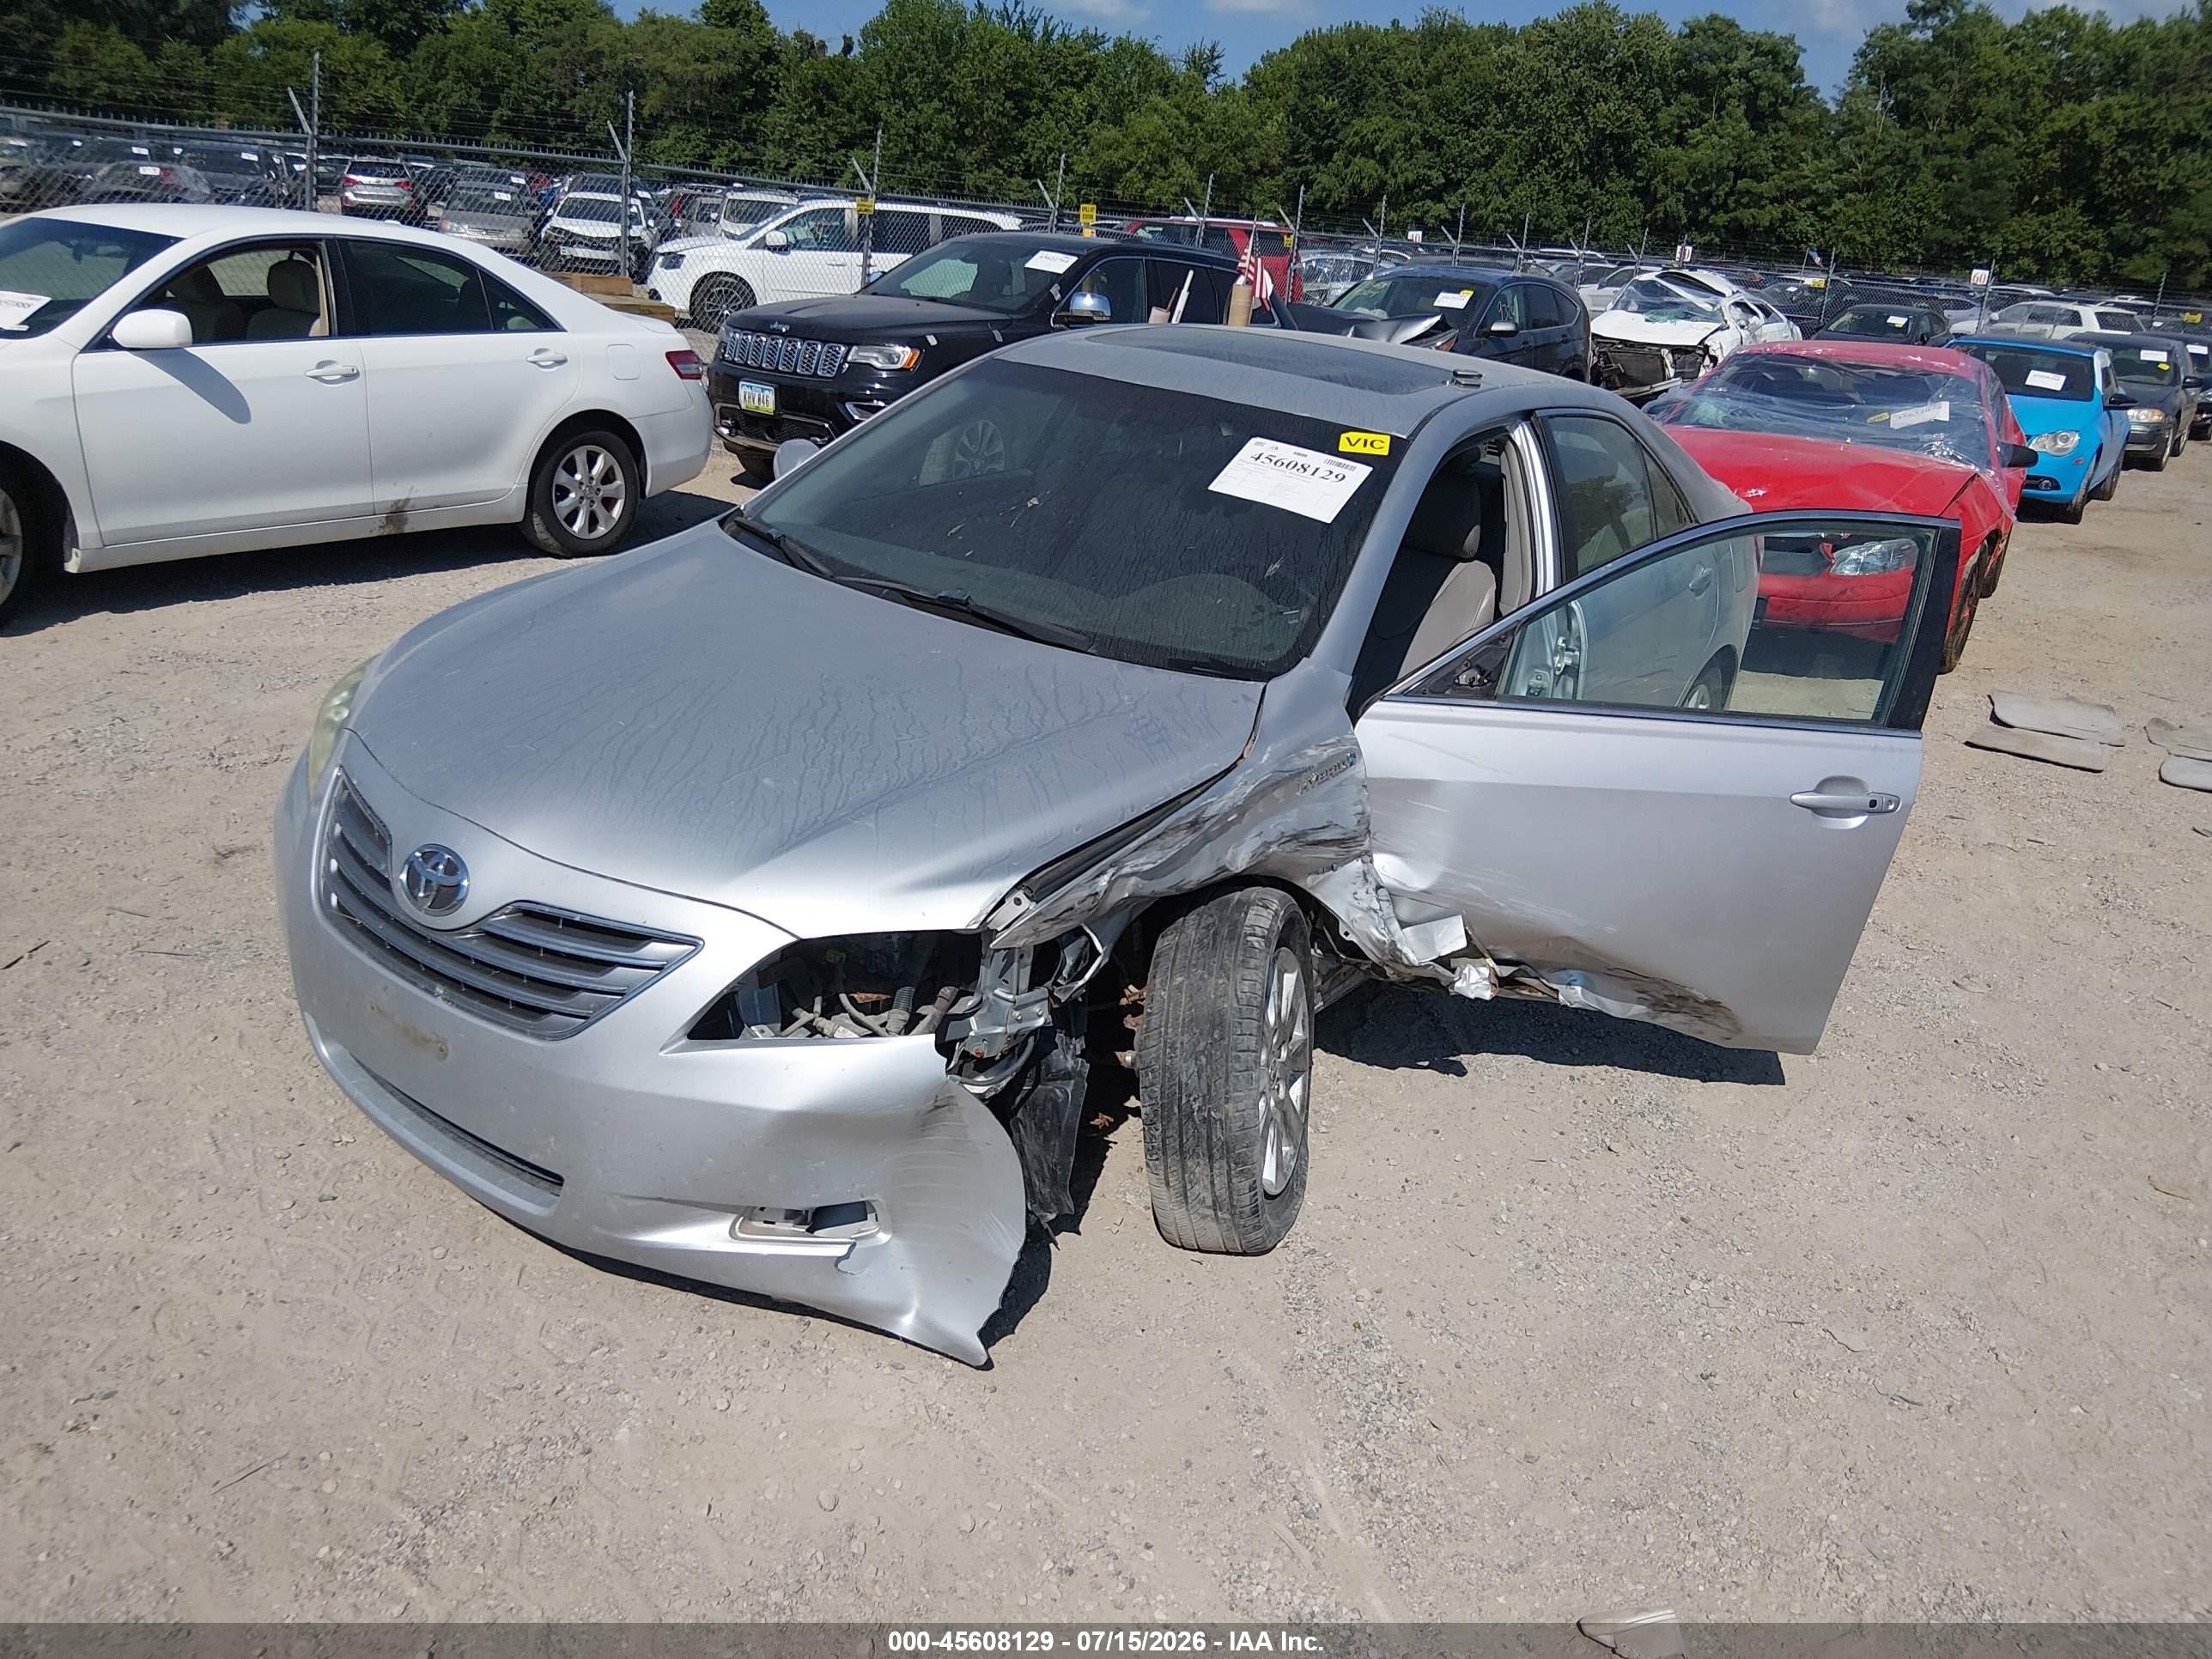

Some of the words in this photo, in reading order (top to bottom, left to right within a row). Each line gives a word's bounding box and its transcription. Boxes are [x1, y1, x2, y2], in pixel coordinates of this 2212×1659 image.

[1972, 271, 1986, 284] 60
[1346, 437, 1385, 449] VIC
[1250, 452, 1346, 483] 45608129
